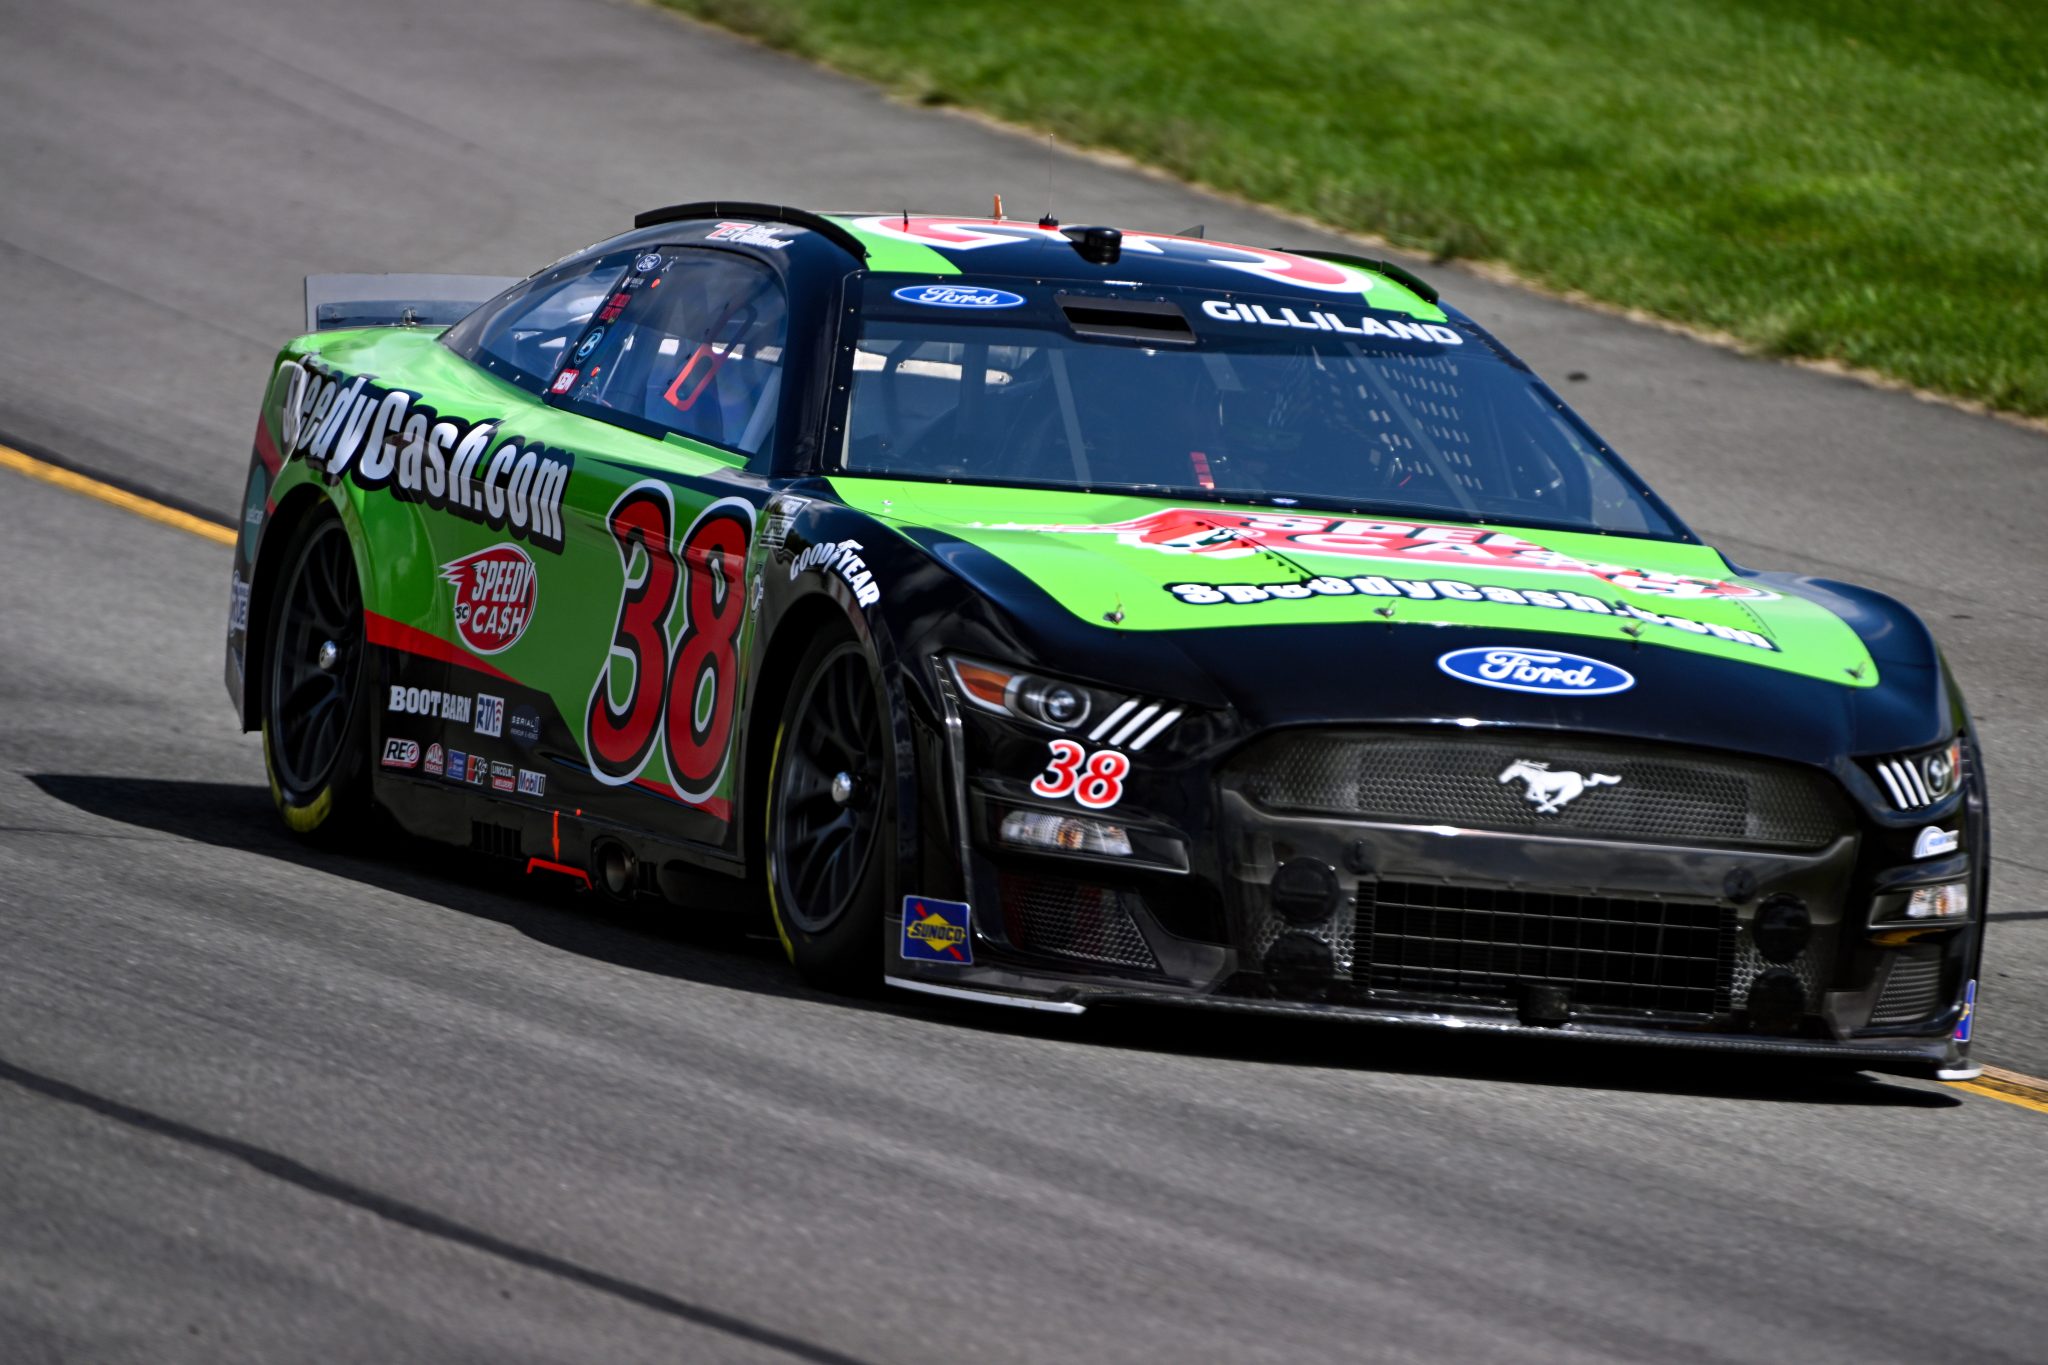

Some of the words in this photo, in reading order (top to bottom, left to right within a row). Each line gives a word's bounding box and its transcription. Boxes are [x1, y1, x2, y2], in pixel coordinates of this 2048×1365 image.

[917, 286, 1001, 306] Ford
[1201, 300, 1464, 345] GILLILAND
[471, 560, 536, 603] SPEEDY
[790, 539, 880, 608] GOODYEAR
[585, 479, 757, 803] 38
[1475, 649, 1599, 689] Ford
[388, 685, 441, 717] BOOT
[441, 693, 472, 723] BARN
[511, 715, 535, 728] SERIAL
[519, 770, 539, 792] Mobil
[1031, 739, 1130, 809] 38
[908, 921, 964, 944] SUNOCO
